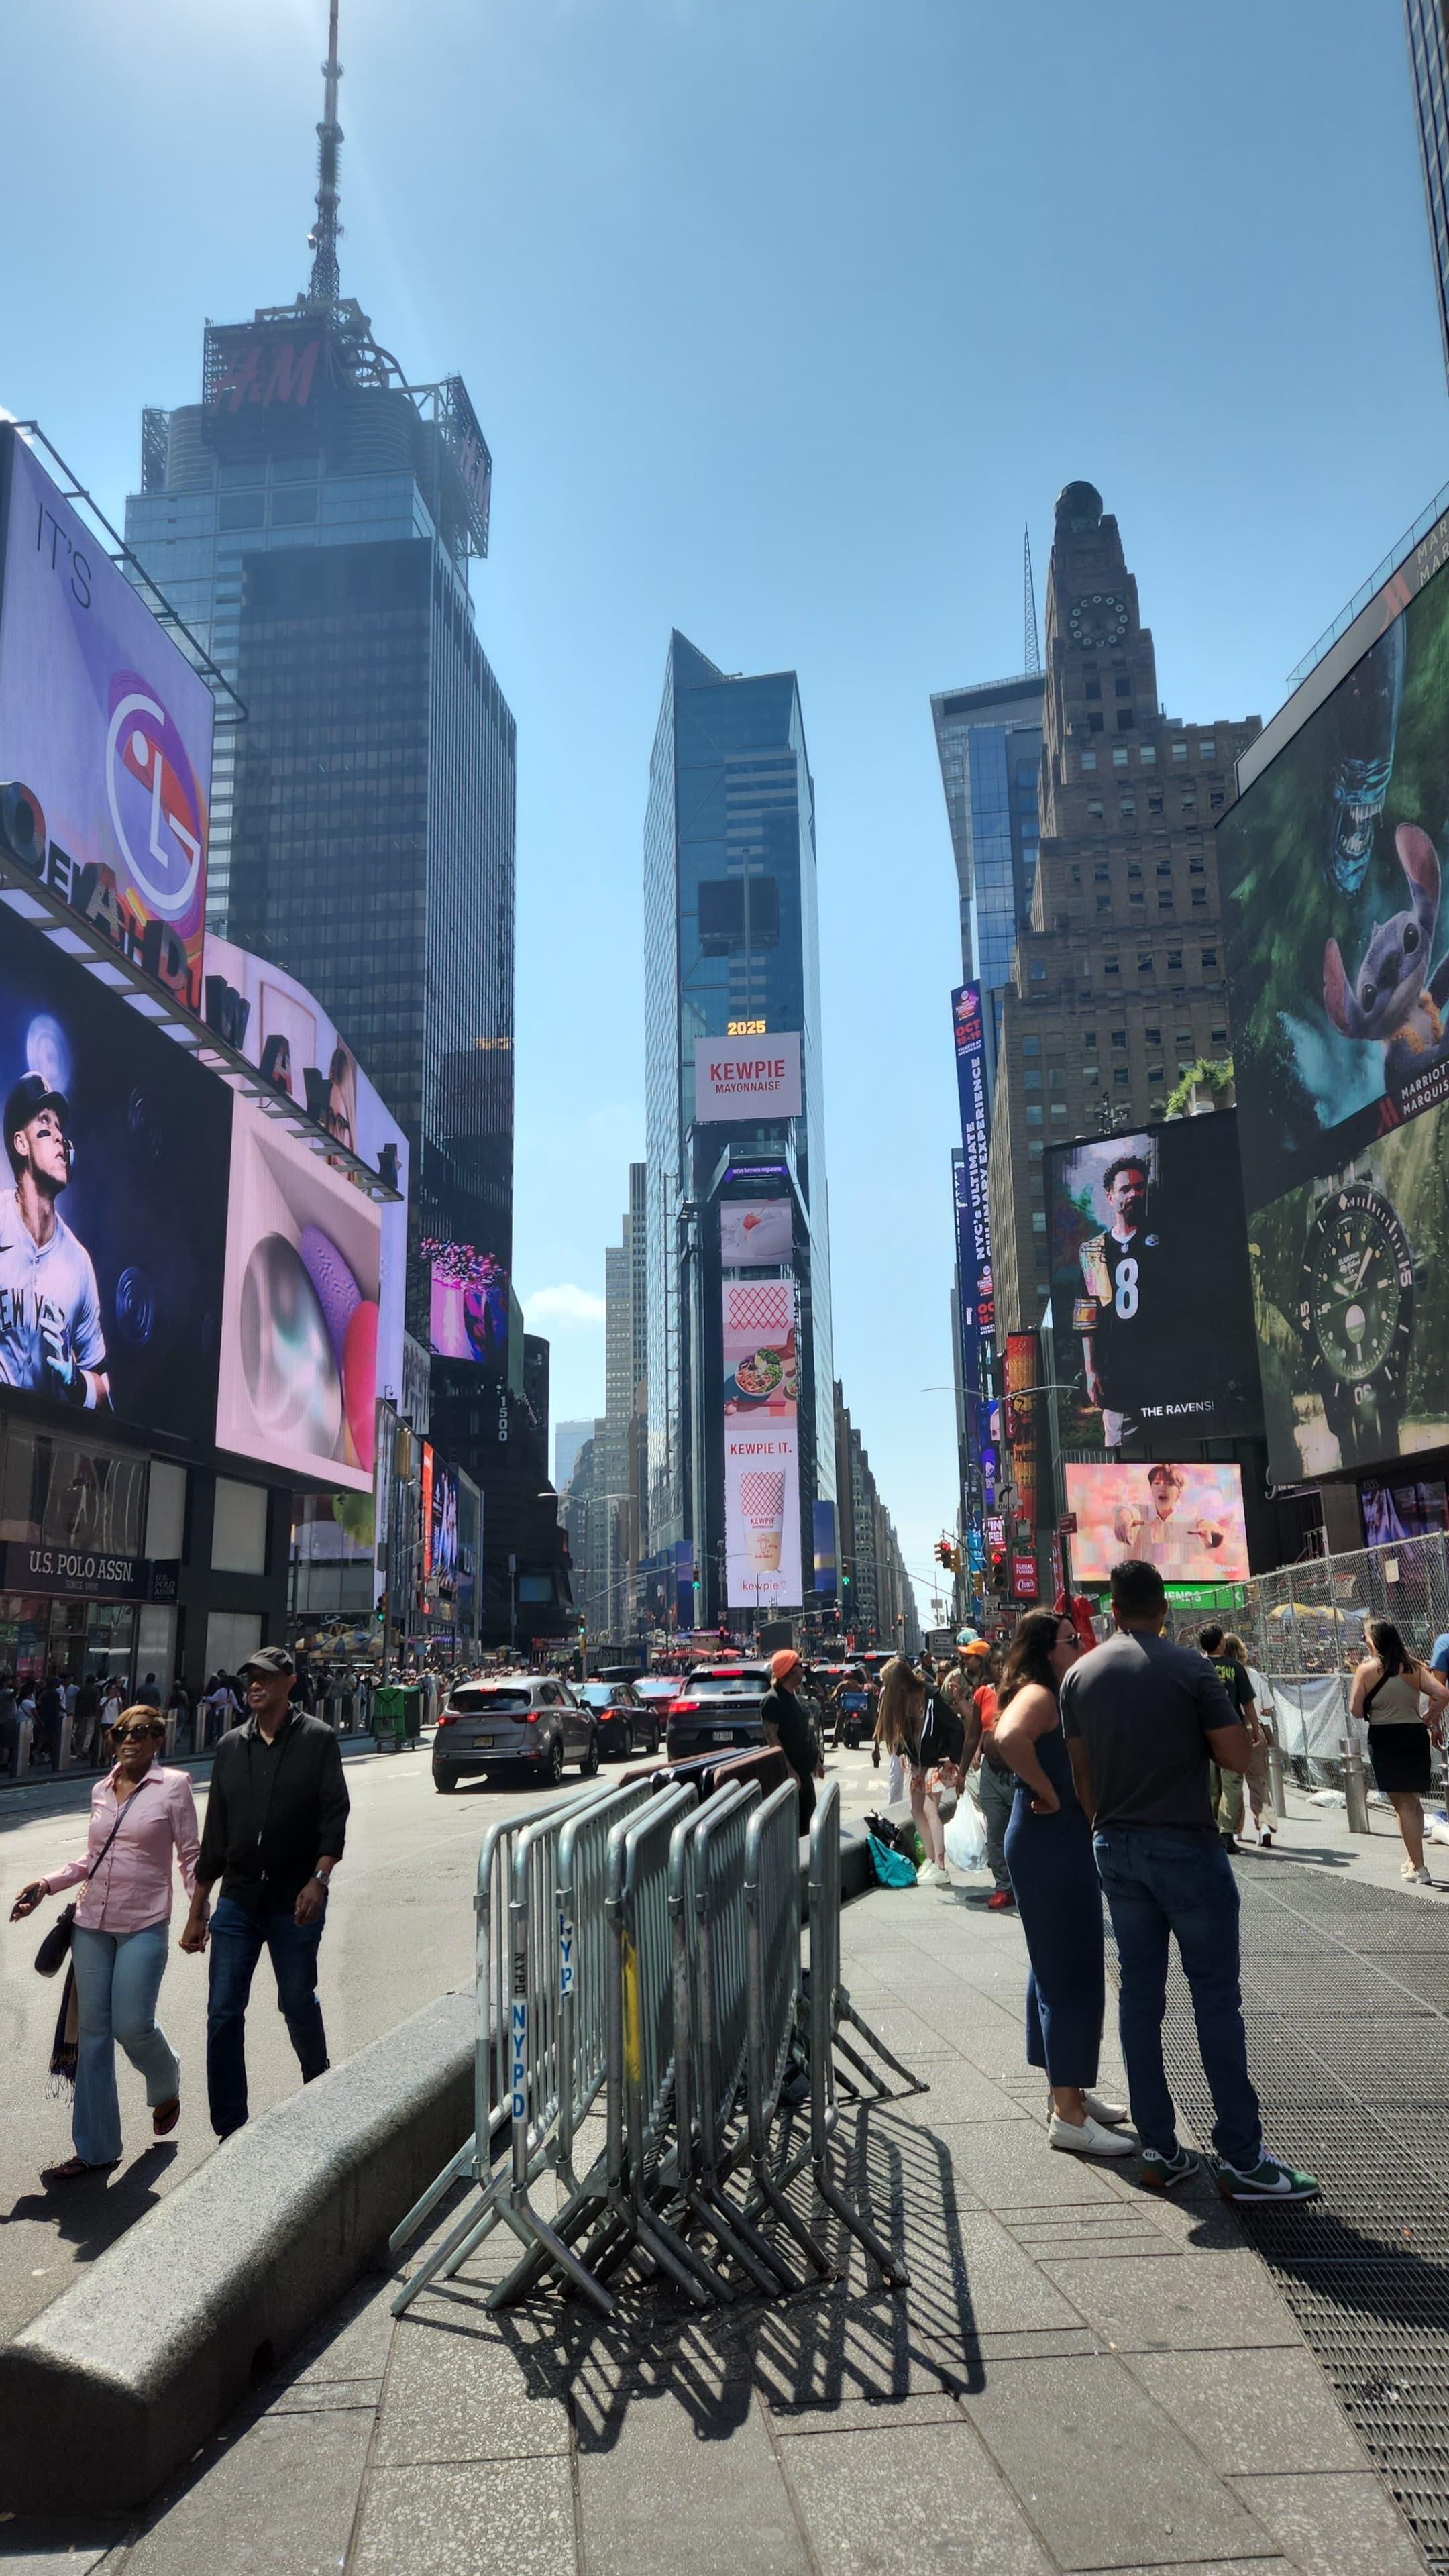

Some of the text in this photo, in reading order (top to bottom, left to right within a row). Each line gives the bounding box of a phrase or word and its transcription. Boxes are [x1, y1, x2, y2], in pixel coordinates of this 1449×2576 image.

[727, 1020, 766, 1036] 2025
[955, 1019, 980, 1036] OCT
[710, 1059, 786, 1081] KEWPIE
[1401, 1059, 1449, 1100] MARRIOT
[716, 1081, 781, 1094] MAYONNAISE
[1403, 1079, 1449, 1116] MARQUIS
[971, 1057, 988, 1165] EXPERIENCE
[966, 1121, 981, 1207] ULTIMATE
[1115, 1258, 1139, 1320] 8
[977, 1302, 994, 1315] OC
[498, 1395, 508, 1442] 1500
[1140, 1401, 1215, 1417] THE RAVENS!
[730, 1442, 792, 1455] KEWPIE IT.
[750, 1517, 775, 1525] KEWPIE
[29, 1550, 135, 1582] U.S. POLO ASSN.
[742, 1579, 779, 1593] kewpie
[986, 1607, 1000, 1615] 25
[512, 2004, 526, 2118] NYPD
